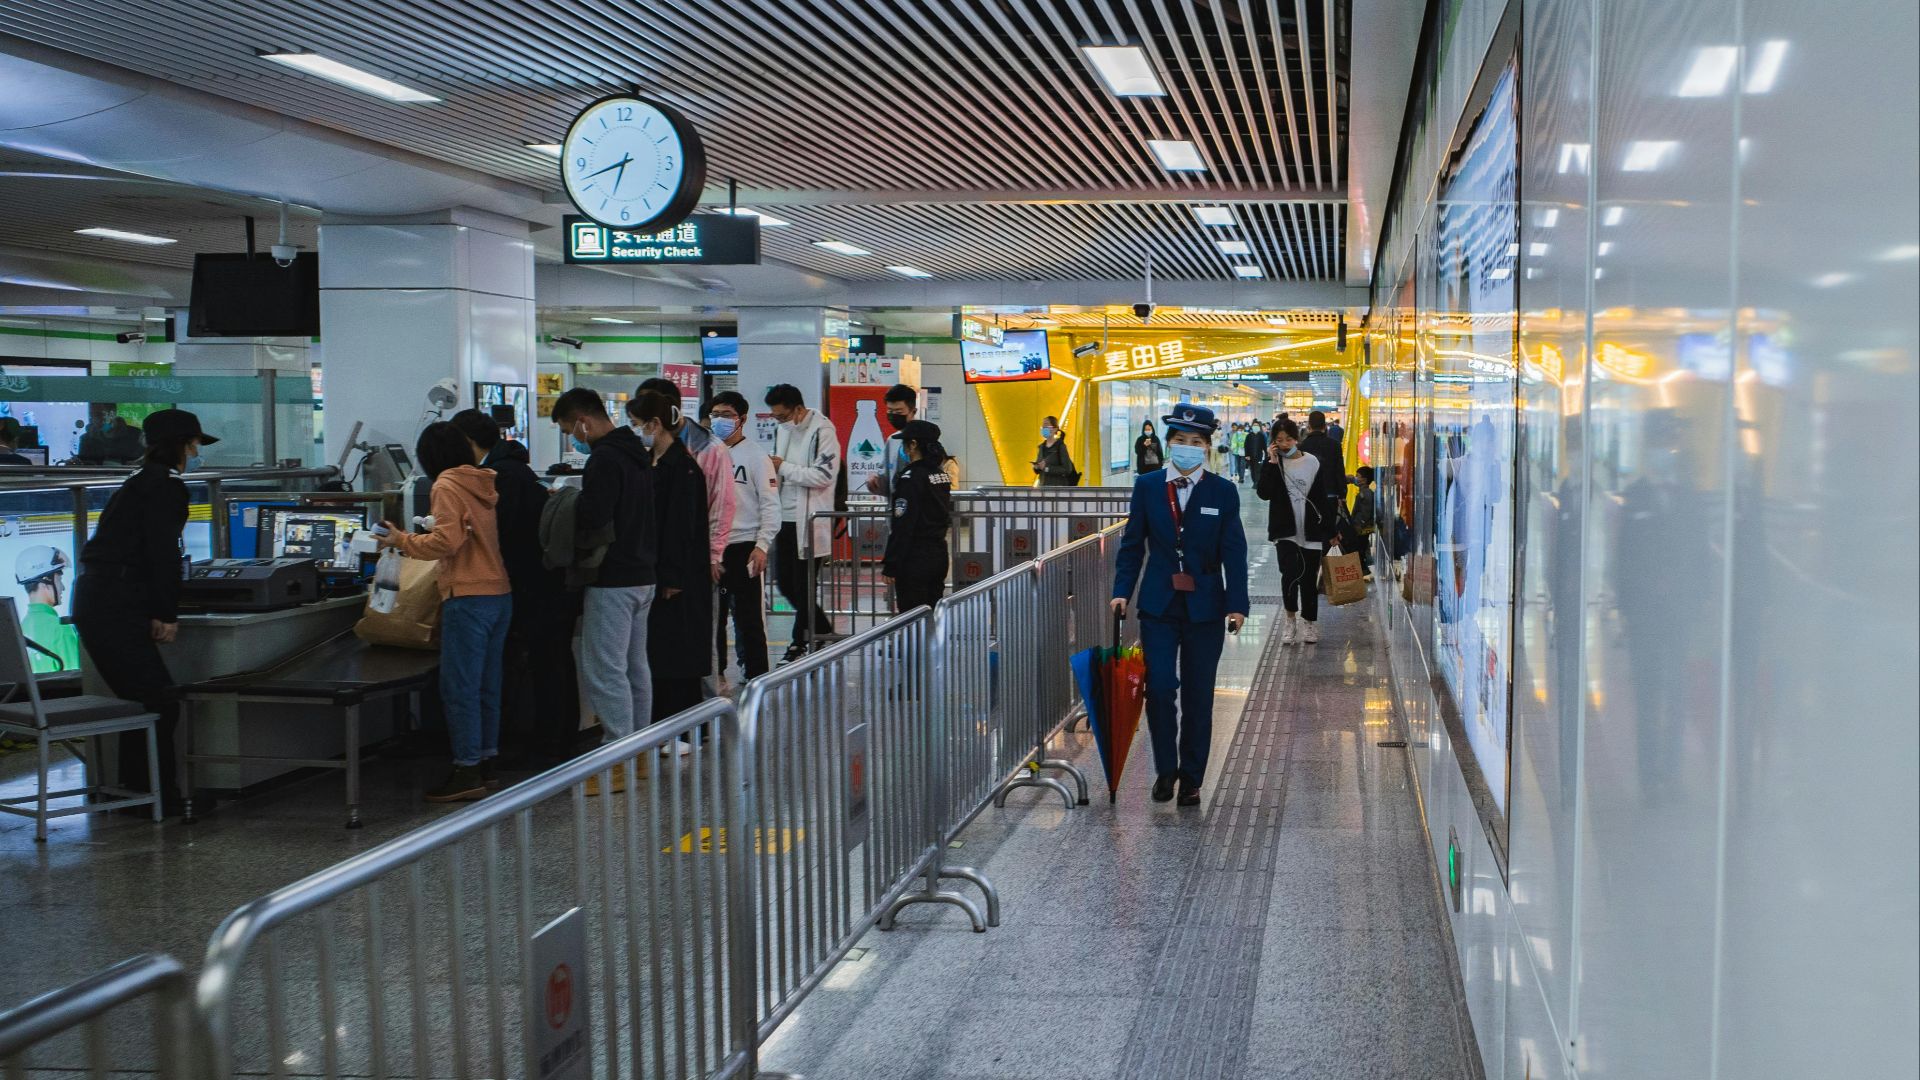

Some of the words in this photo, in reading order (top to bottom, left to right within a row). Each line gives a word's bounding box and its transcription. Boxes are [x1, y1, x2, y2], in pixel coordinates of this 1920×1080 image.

[617, 106, 633, 122] 12
[576, 157, 587, 173] 9
[664, 155, 674, 171] 3
[620, 205, 630, 221] 6
[612, 246, 662, 259] Security
[663, 246, 702, 257] Check
[1104, 339, 1185, 374] 麦田里
